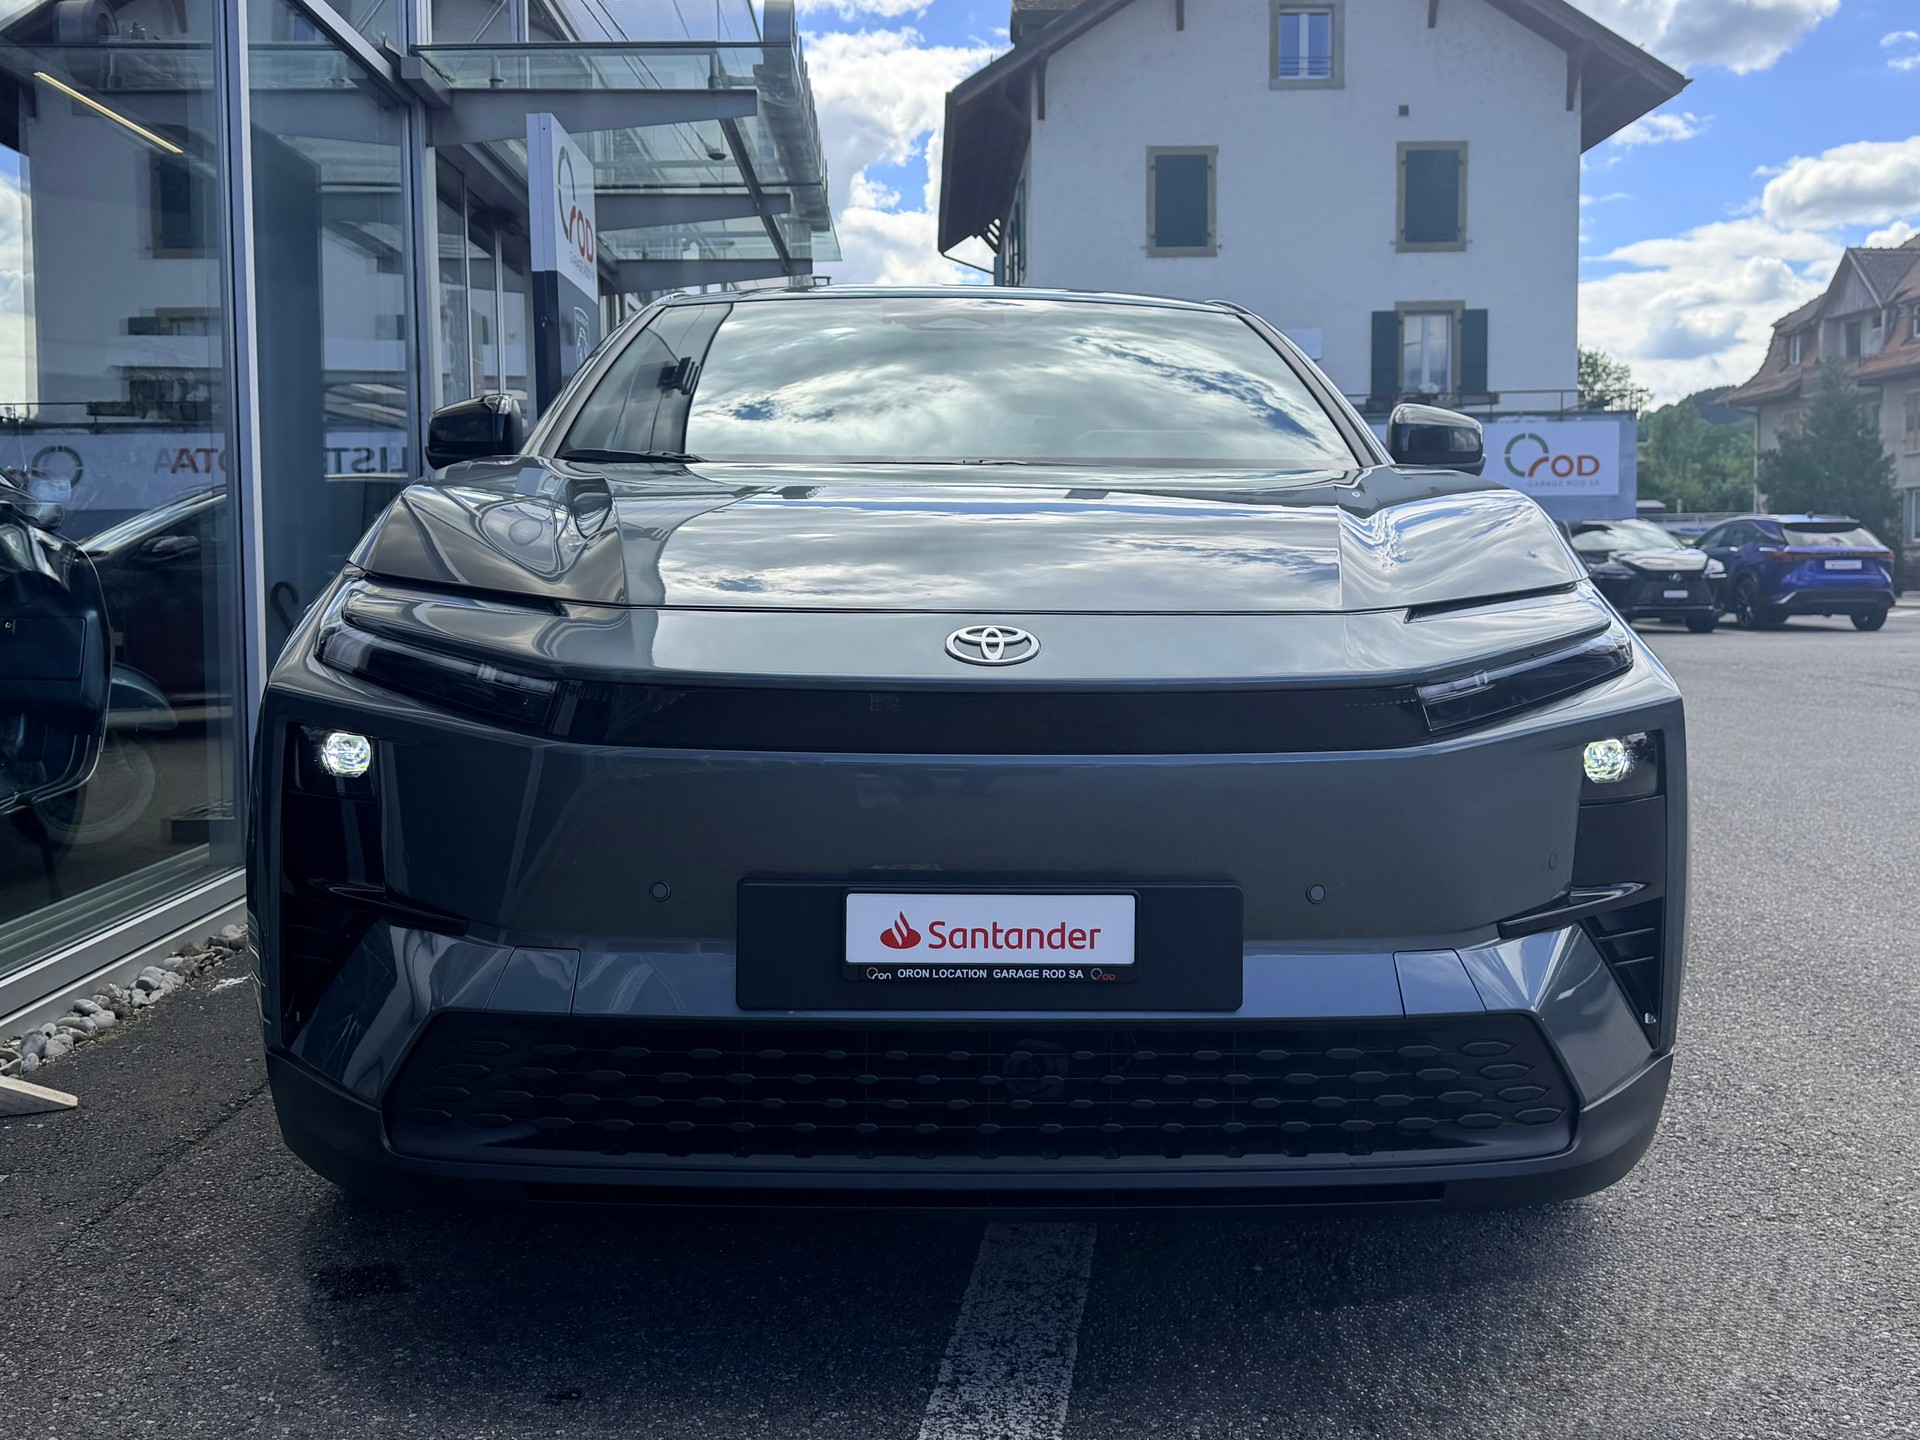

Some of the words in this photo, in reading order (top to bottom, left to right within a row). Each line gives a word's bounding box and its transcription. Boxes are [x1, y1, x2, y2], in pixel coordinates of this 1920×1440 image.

[1526, 479, 1563, 488] GARAGE
[927, 920, 1101, 950] Santander
[897, 968, 930, 978] ORON
[932, 968, 987, 979] LOCATION
[992, 969, 1040, 979] GARAGE
[1042, 969, 1066, 979] ROD
[1068, 969, 1084, 979] SA
